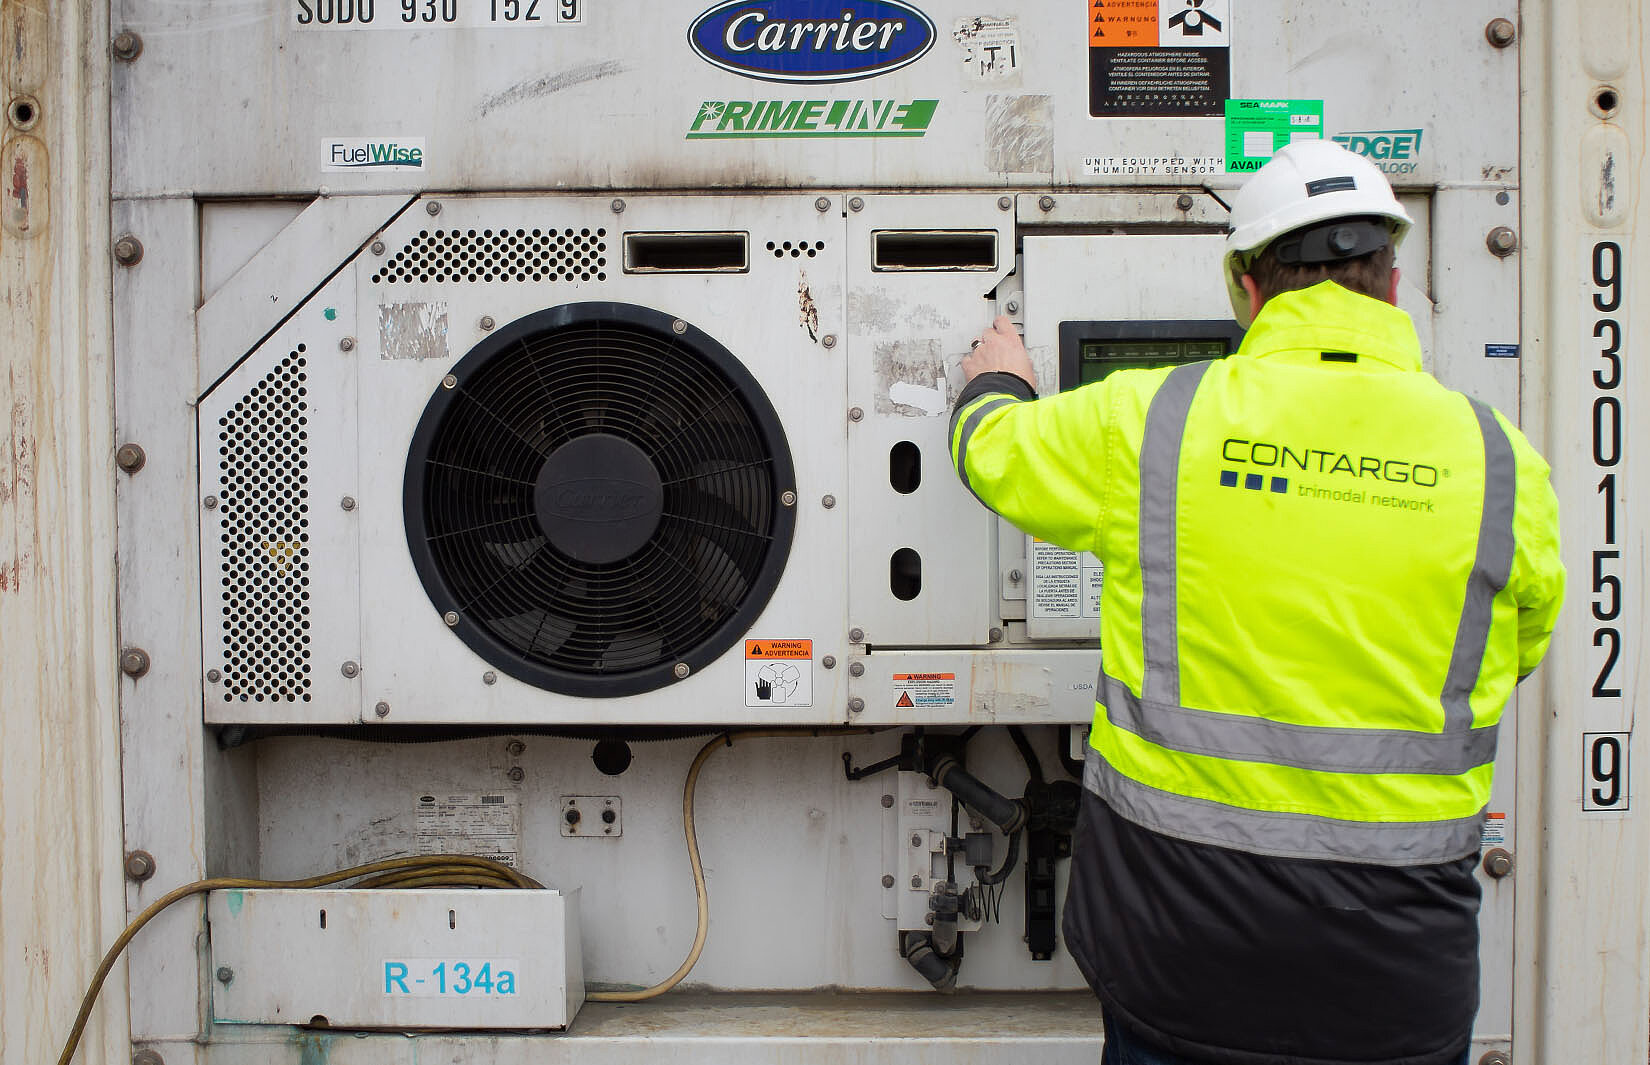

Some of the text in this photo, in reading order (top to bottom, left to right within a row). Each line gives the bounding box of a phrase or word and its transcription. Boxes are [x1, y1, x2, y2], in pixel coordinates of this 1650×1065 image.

[401, 0, 457, 23] 930
[726, 12, 904, 52] Carrier
[691, 99, 939, 131] PRIMELINE
[331, 143, 423, 163] FuelWise
[1085, 158, 1114, 166] UNIT
[1122, 158, 1185, 166] EQUIPPED
[1093, 166, 1216, 174] HUMIDITY SENSOR
[1298, 484, 1434, 513] trimodal network
[1592, 736, 1621, 807] 9
[384, 961, 516, 994] R-134a
